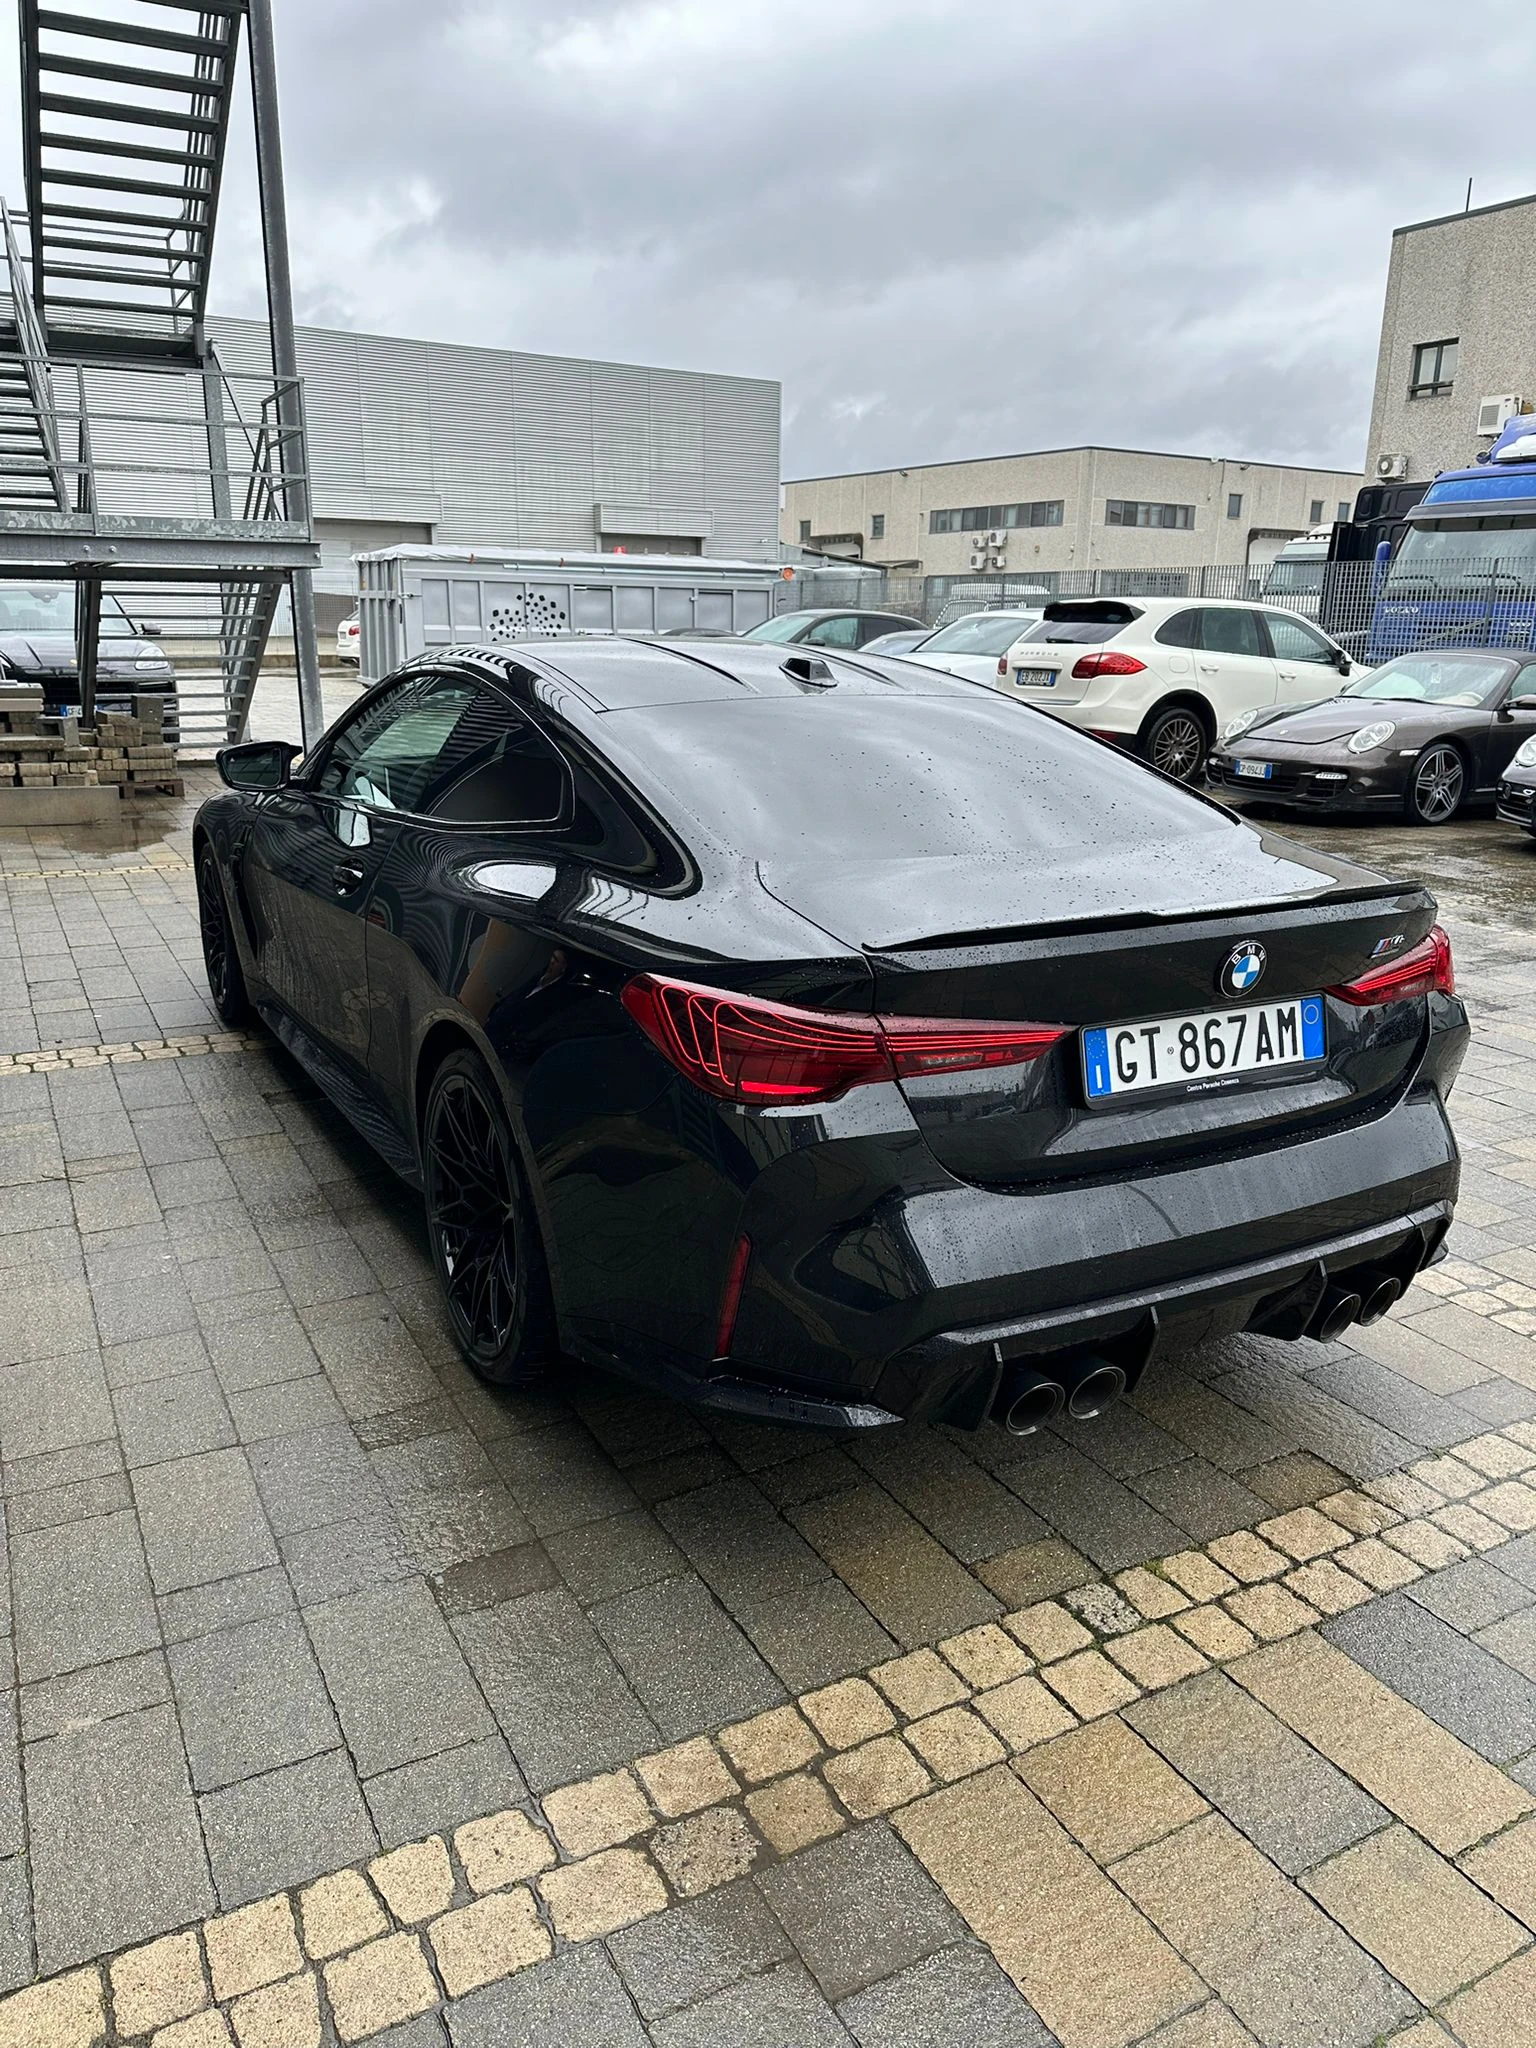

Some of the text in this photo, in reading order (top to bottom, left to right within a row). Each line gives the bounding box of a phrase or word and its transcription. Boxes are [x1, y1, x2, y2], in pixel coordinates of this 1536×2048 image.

[1231, 945, 1266, 964] BMW
[1115, 1025, 1161, 1084] GT
[1178, 1006, 1298, 1073] 867AM
